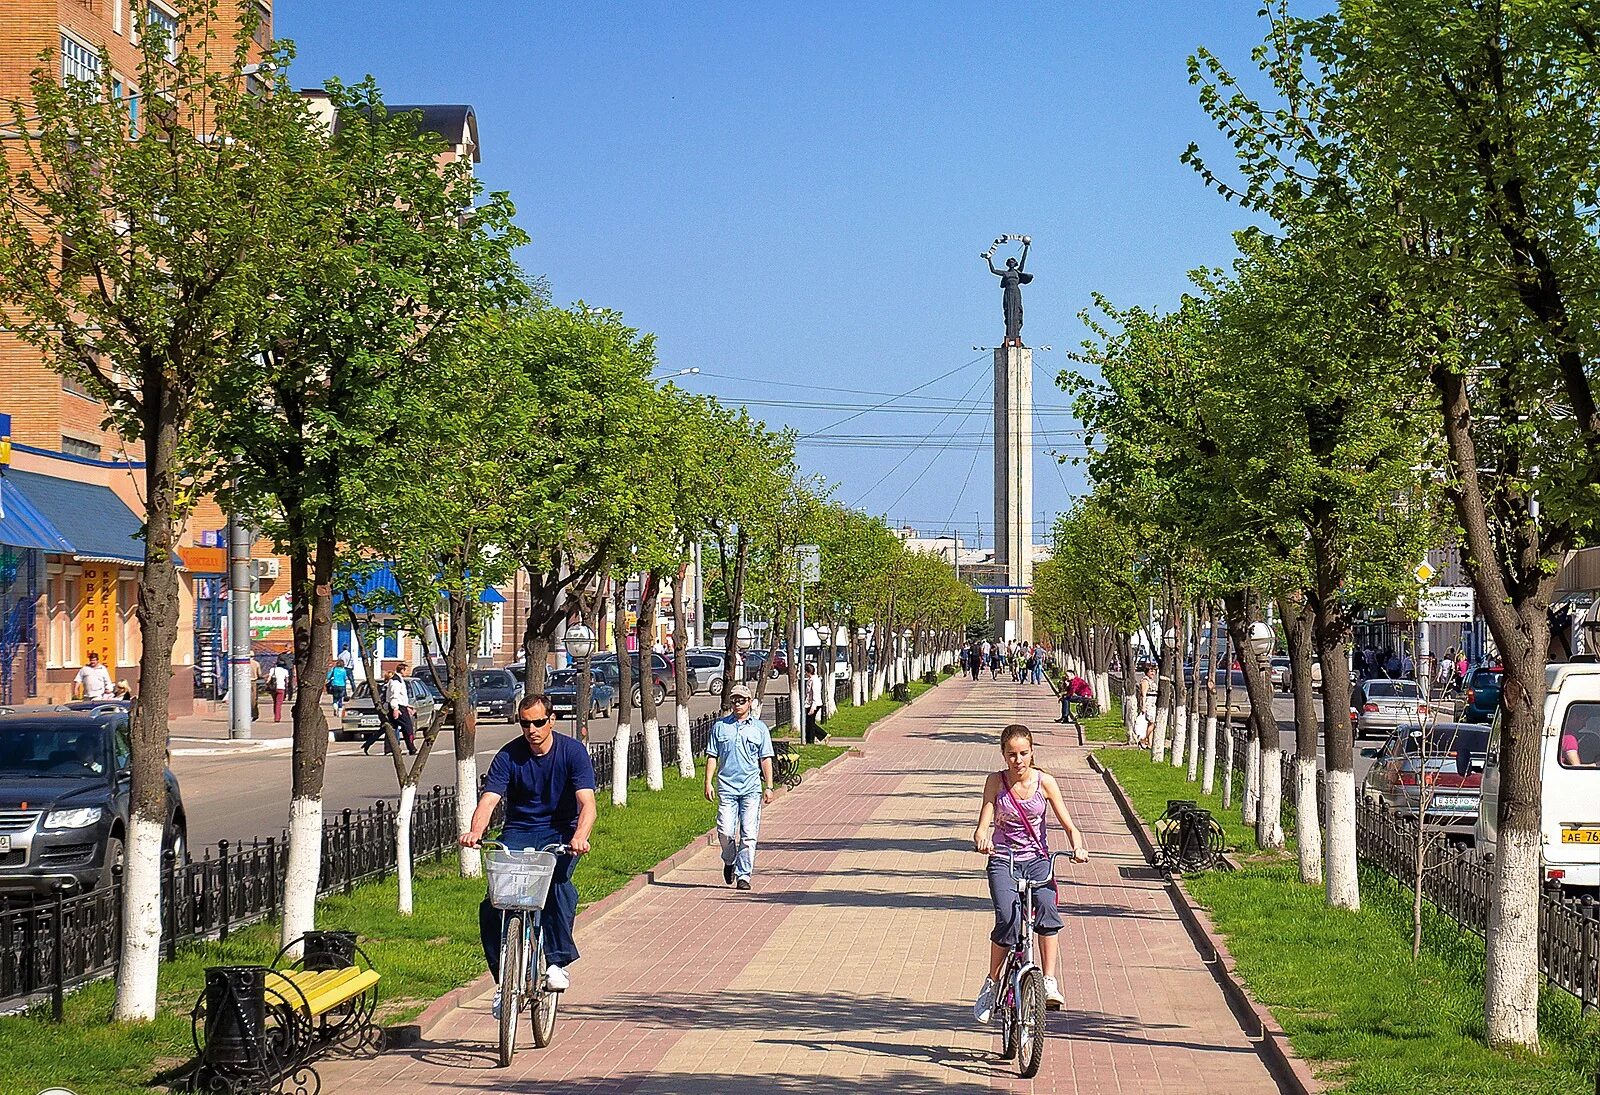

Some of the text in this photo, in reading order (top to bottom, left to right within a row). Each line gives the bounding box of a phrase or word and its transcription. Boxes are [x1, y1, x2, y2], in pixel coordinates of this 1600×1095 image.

[250, 600, 281, 614] ОМ
[1568, 831, 1600, 842] АЕ 76
